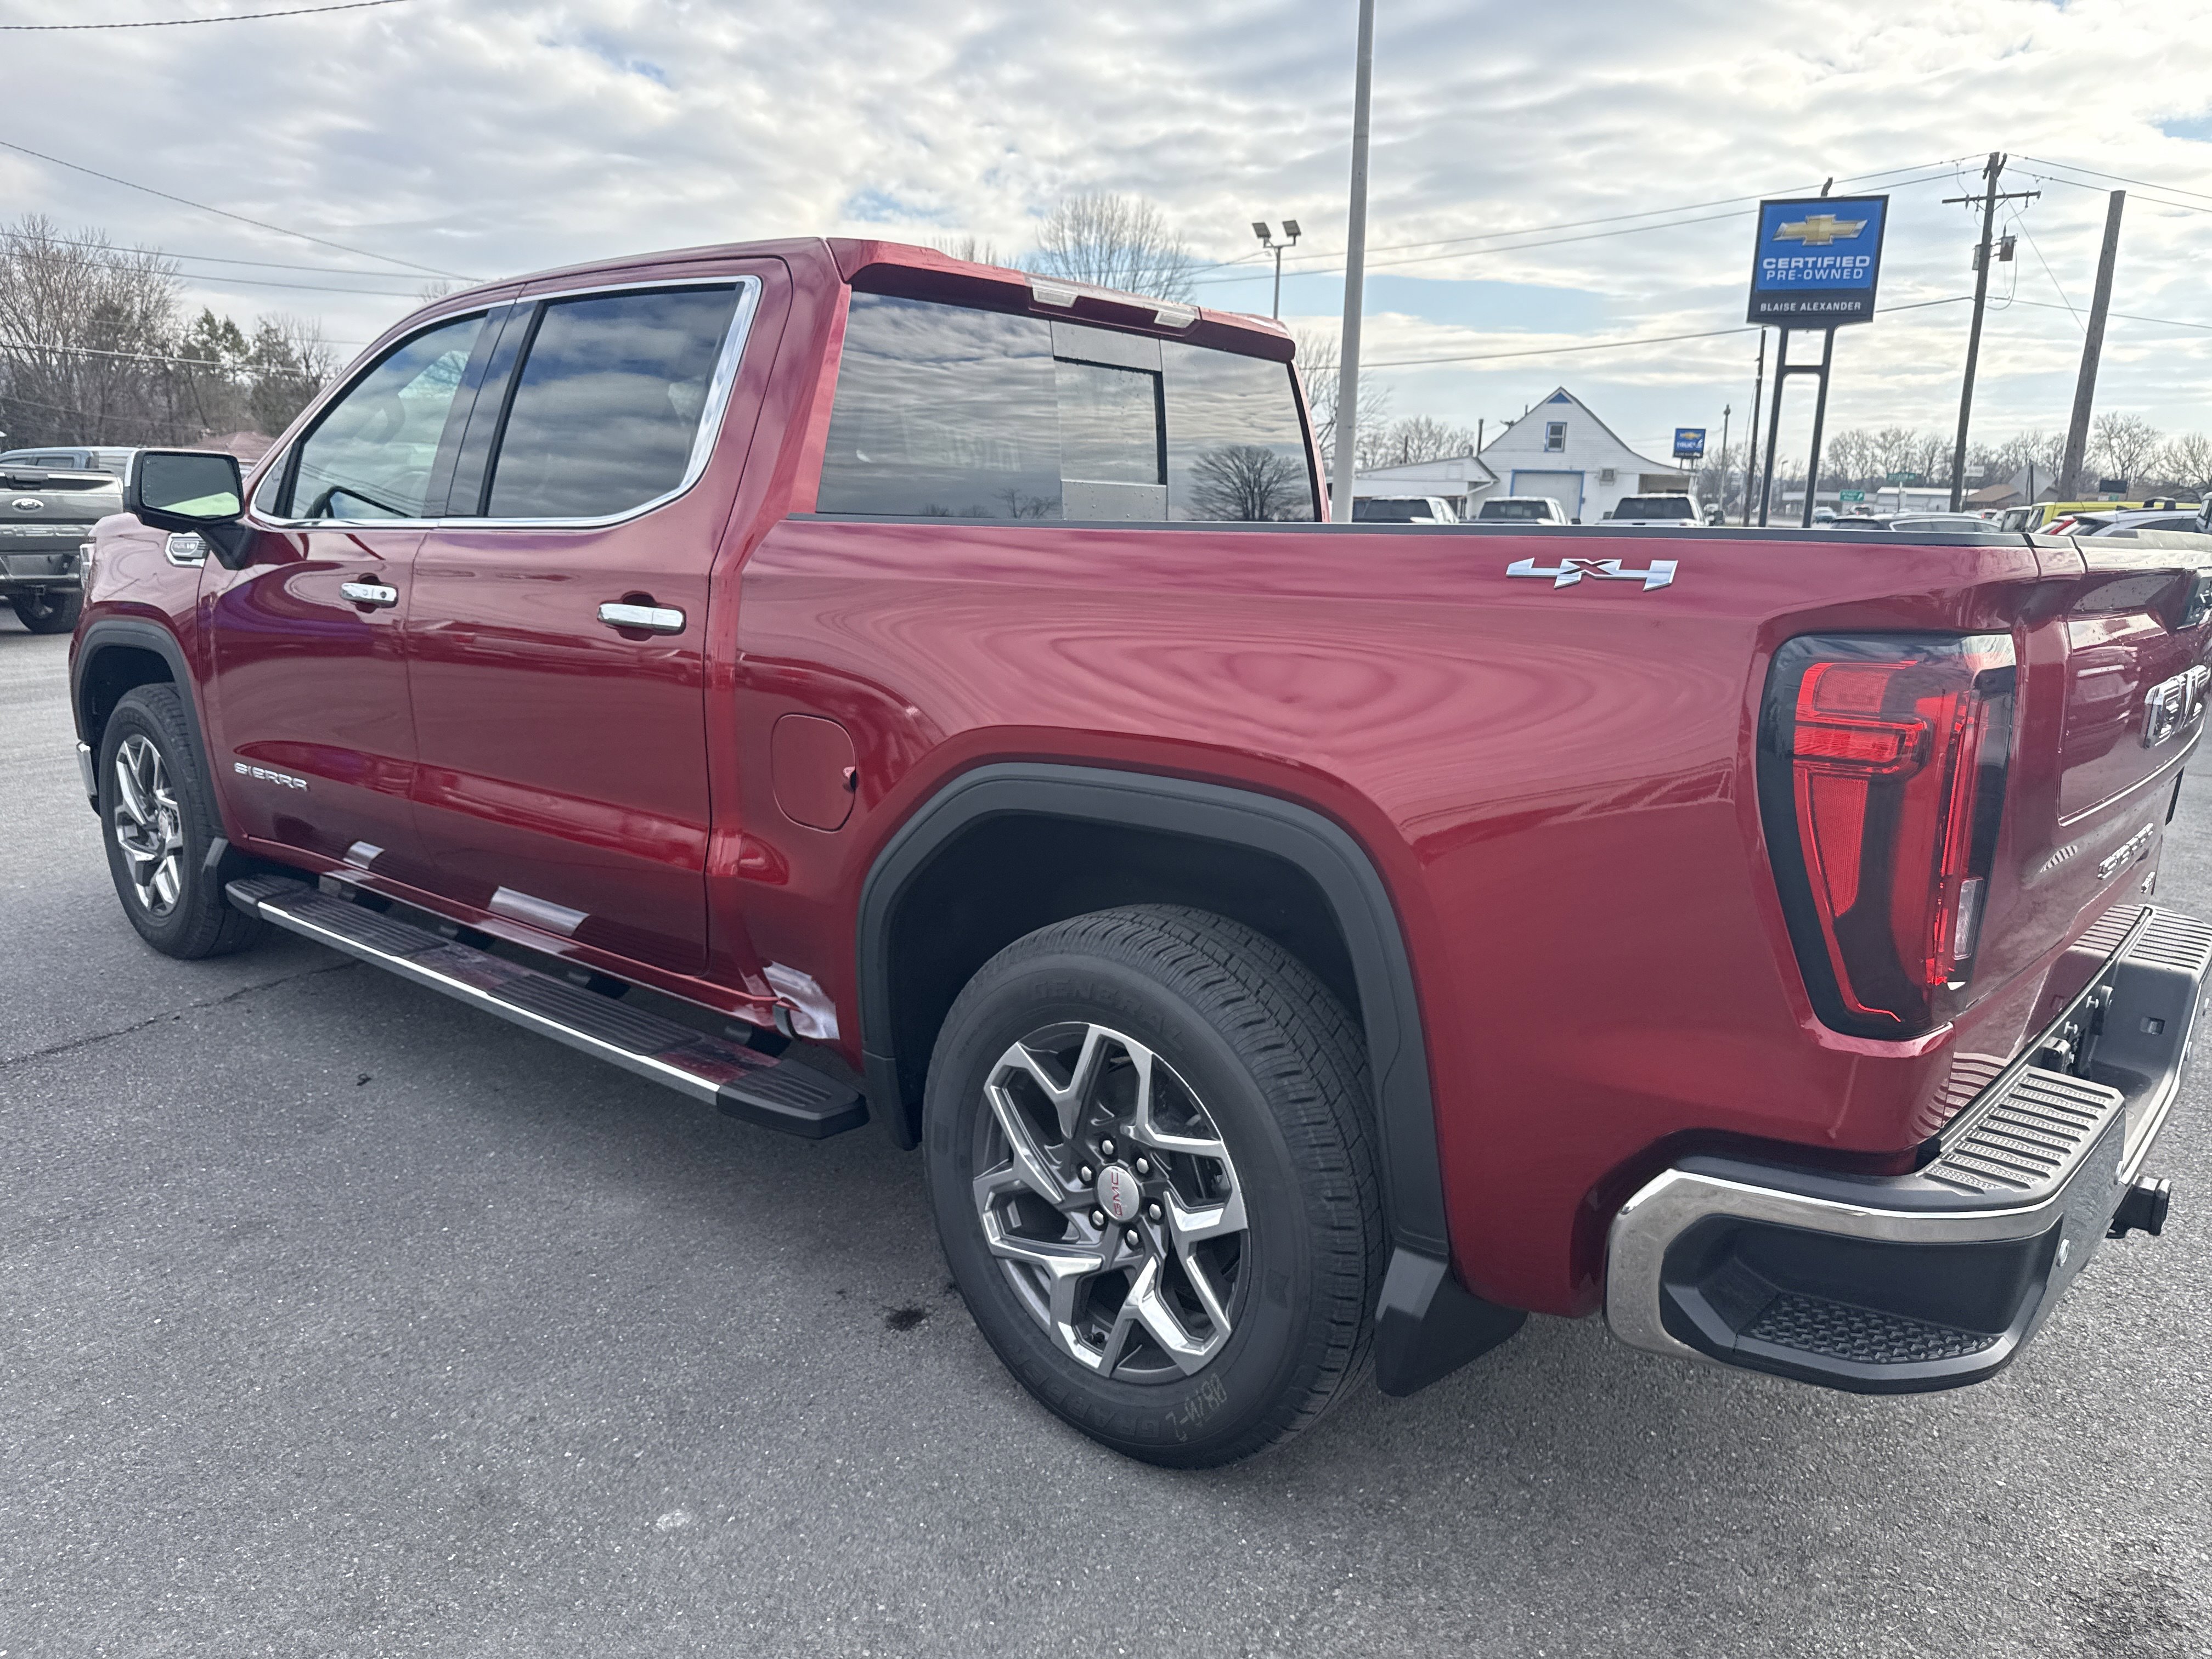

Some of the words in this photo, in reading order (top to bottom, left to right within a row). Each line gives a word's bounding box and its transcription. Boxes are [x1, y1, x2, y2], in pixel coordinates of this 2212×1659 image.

[1762, 255, 1870, 269] CERTIFIED
[1766, 268, 1863, 281] PRE-OWNED
[1760, 302, 1796, 312] BLAISE
[1799, 302, 1861, 311] ALEXANDER
[234, 762, 308, 792] SIERRA
[1031, 978, 1185, 1054] GENERAL
[1110, 1171, 1123, 1216] GMC
